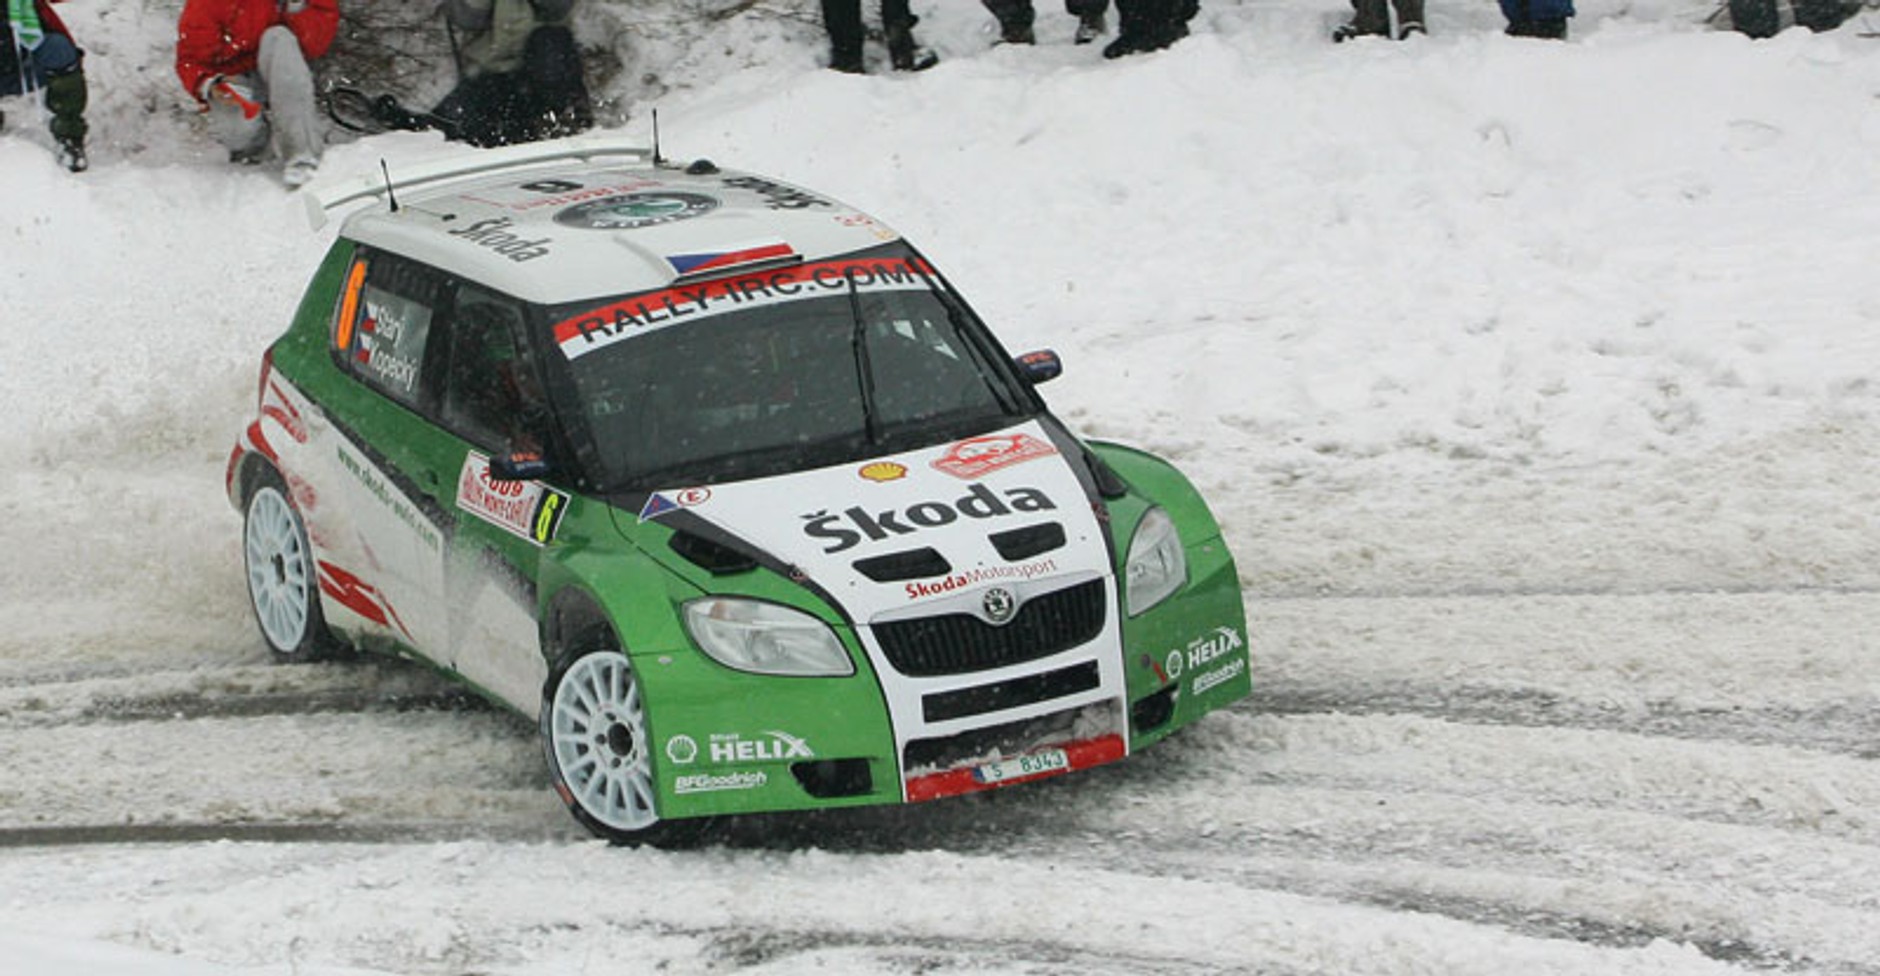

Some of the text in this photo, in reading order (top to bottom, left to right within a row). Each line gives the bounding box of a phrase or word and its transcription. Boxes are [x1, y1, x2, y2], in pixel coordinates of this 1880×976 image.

[447, 216, 553, 262] Škoda
[576, 263, 915, 342] RALLY-IRC.COM
[536, 493, 559, 541] 6
[800, 482, 1057, 554] Škoda
[1188, 627, 1242, 670] HELIX
[710, 730, 815, 762] HELIX
[1019, 750, 1065, 773] 8343
